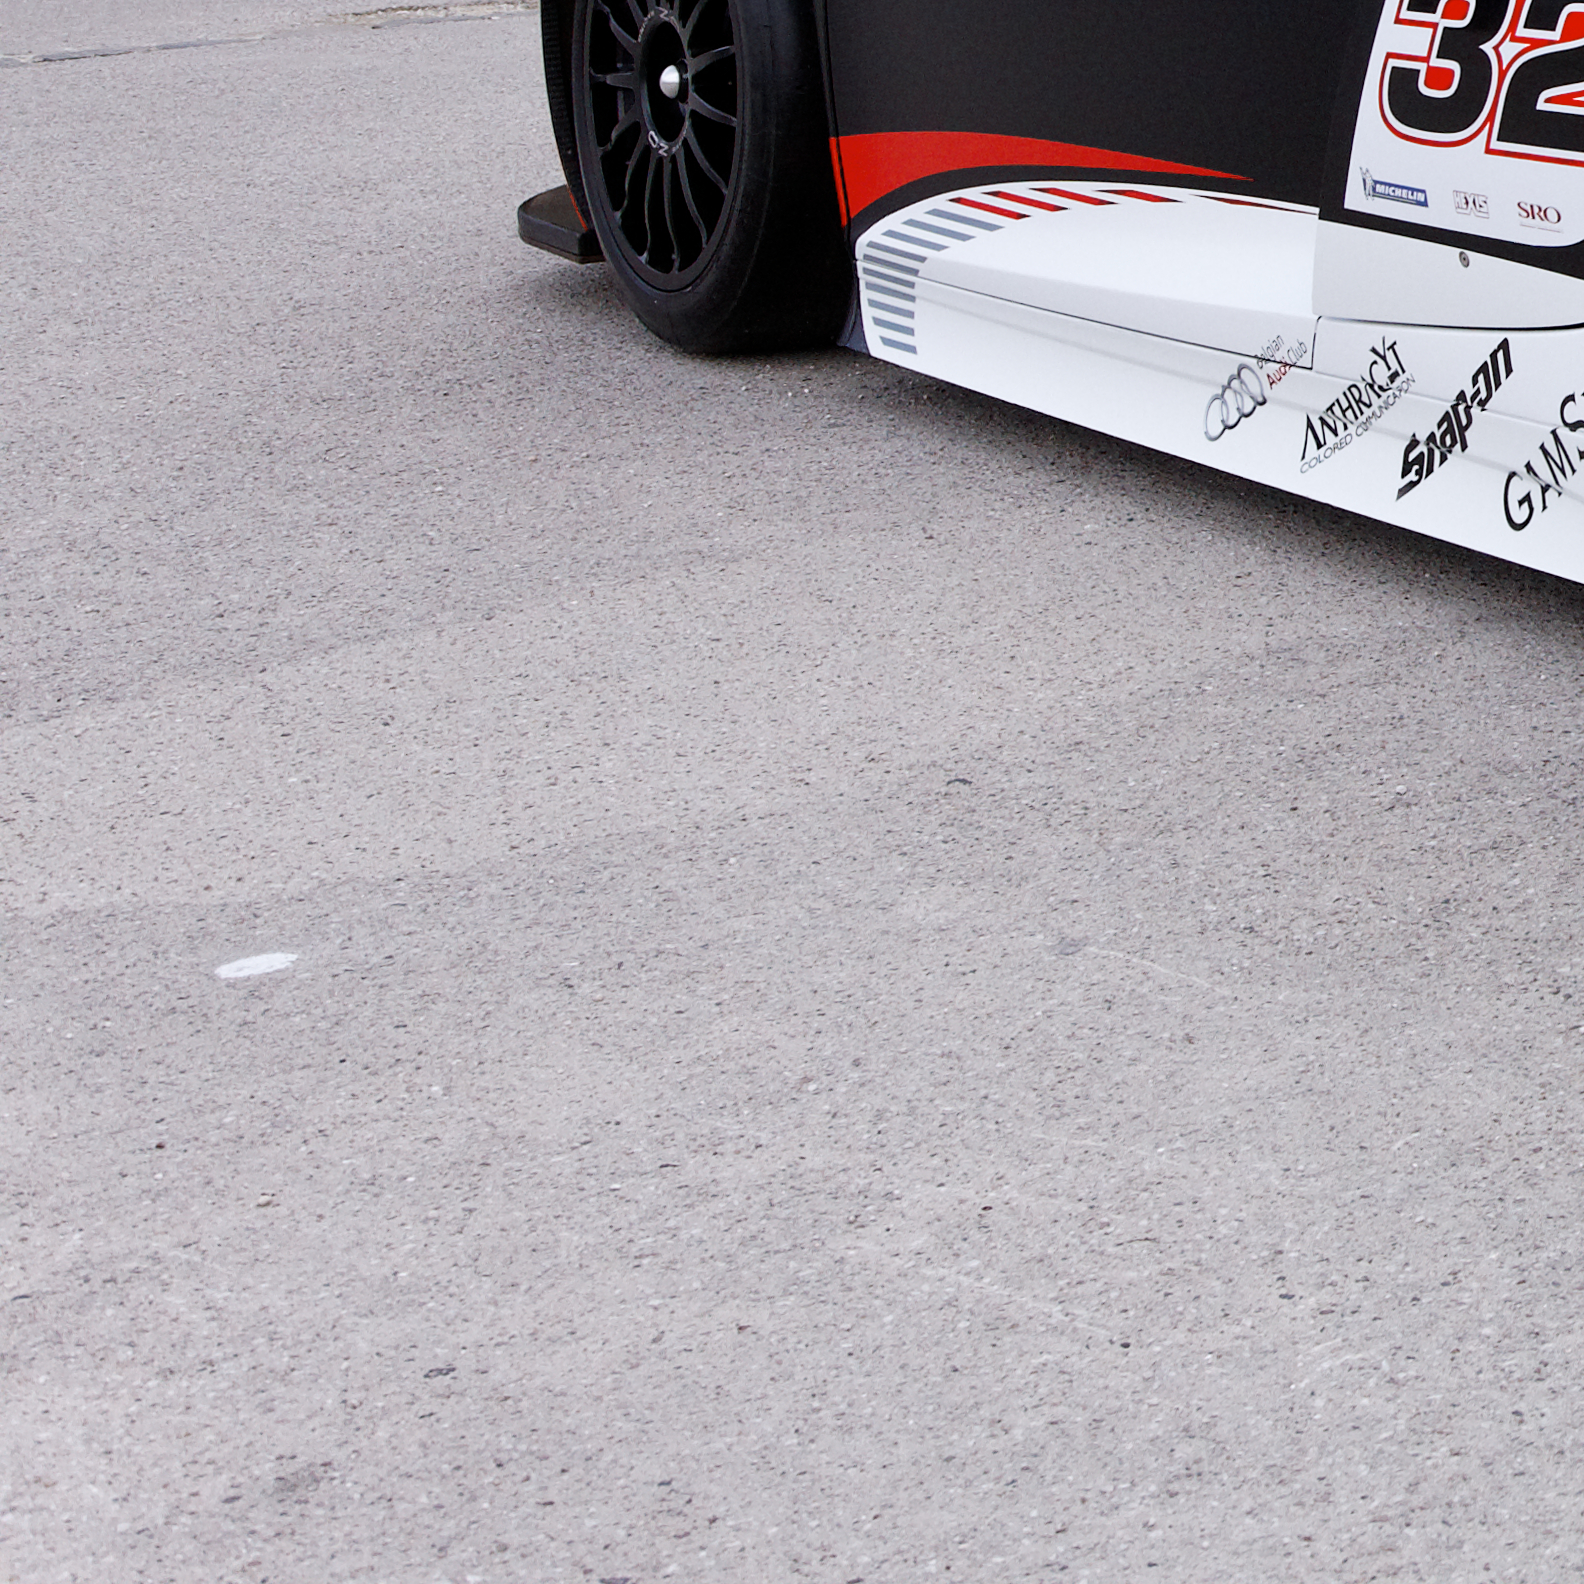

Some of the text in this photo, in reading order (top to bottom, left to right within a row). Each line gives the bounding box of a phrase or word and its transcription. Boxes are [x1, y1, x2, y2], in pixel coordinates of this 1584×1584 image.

[1375, 183, 1426, 203] MICHELIN
[1517, 200, 1562, 225] SRO
[1301, 335, 1407, 462] ANTHRACYT
[1299, 433, 1353, 474] COLORED
